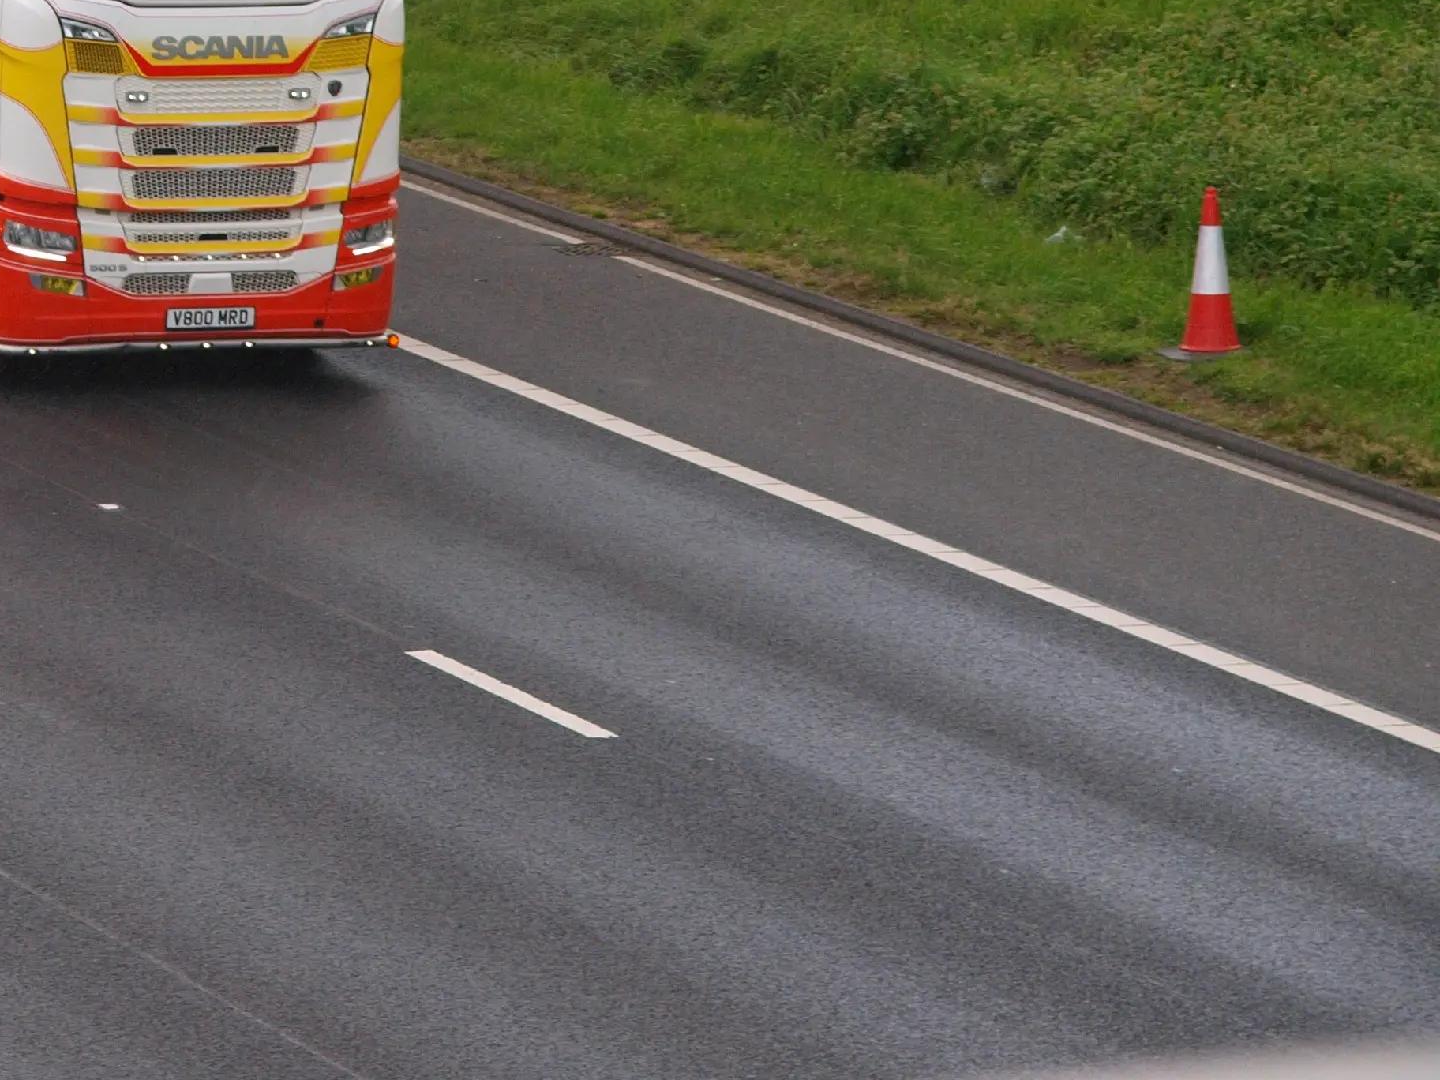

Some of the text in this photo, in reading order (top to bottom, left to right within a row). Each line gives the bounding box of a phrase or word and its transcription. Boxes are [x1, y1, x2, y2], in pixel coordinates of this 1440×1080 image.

[151, 35, 290, 61] SCANIA
[173, 309, 249, 327] V800 MRD
